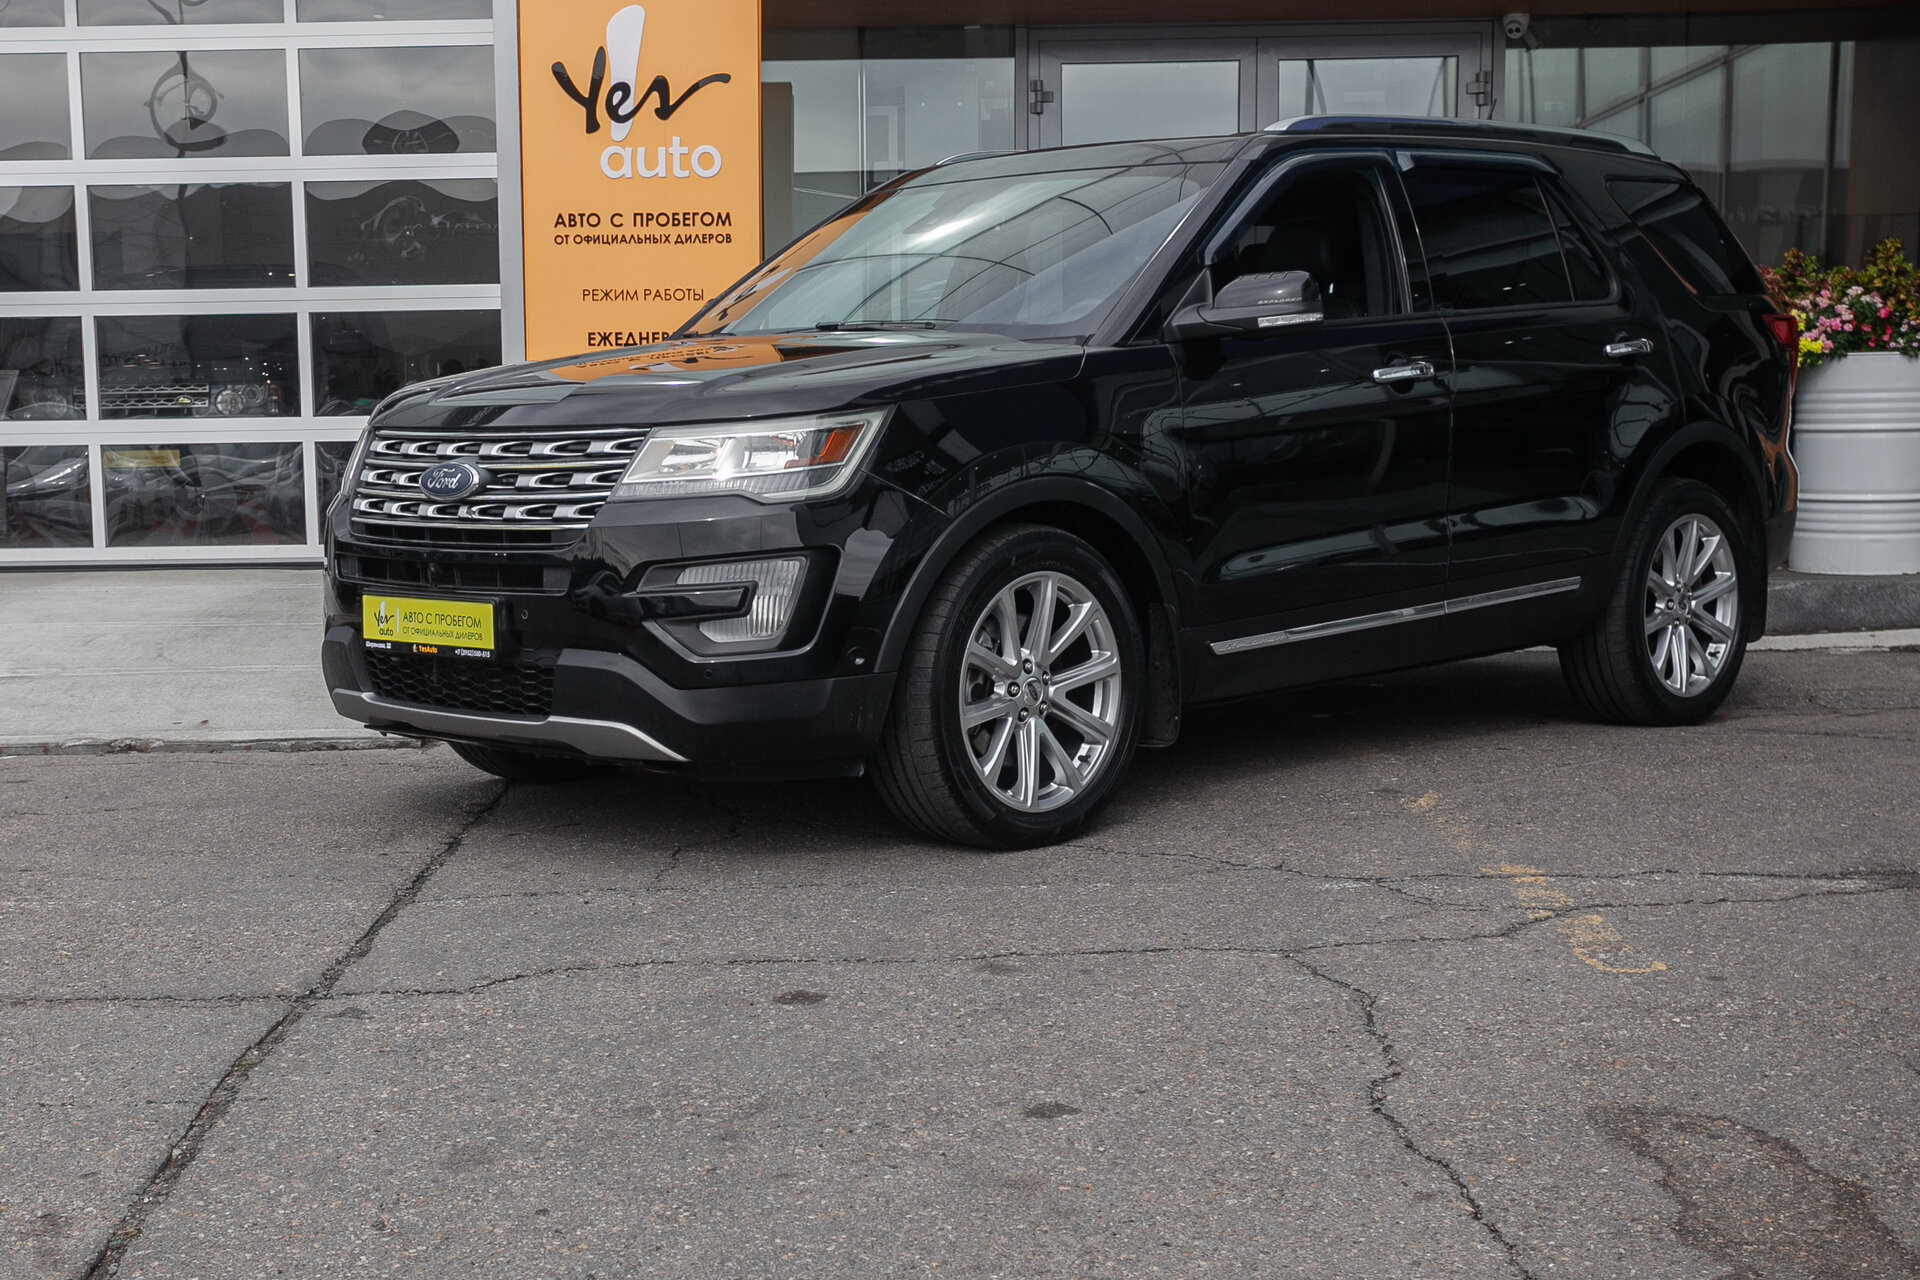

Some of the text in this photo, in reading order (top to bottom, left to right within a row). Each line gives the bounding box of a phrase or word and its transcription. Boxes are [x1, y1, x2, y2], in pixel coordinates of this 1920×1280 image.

[551, 46, 732, 134] Yes
[600, 136, 722, 179] auto
[554, 212, 732, 228] АВТО С ПРОБЕГОМ
[554, 233, 732, 246] ОТ ОФИЦИАЛЬНЫХ ДИЛЕРОВ
[582, 288, 704, 301] РЕЖИМ РАБОТЫ
[427, 468, 462, 489] Ford
[403, 612, 482, 628] АВТО С ПРОБЕГОМ
[379, 627, 394, 637] auto
[403, 626, 483, 641] ОТ ОФИЦИАЛЬНЫХ ДИЛЕРОВ
